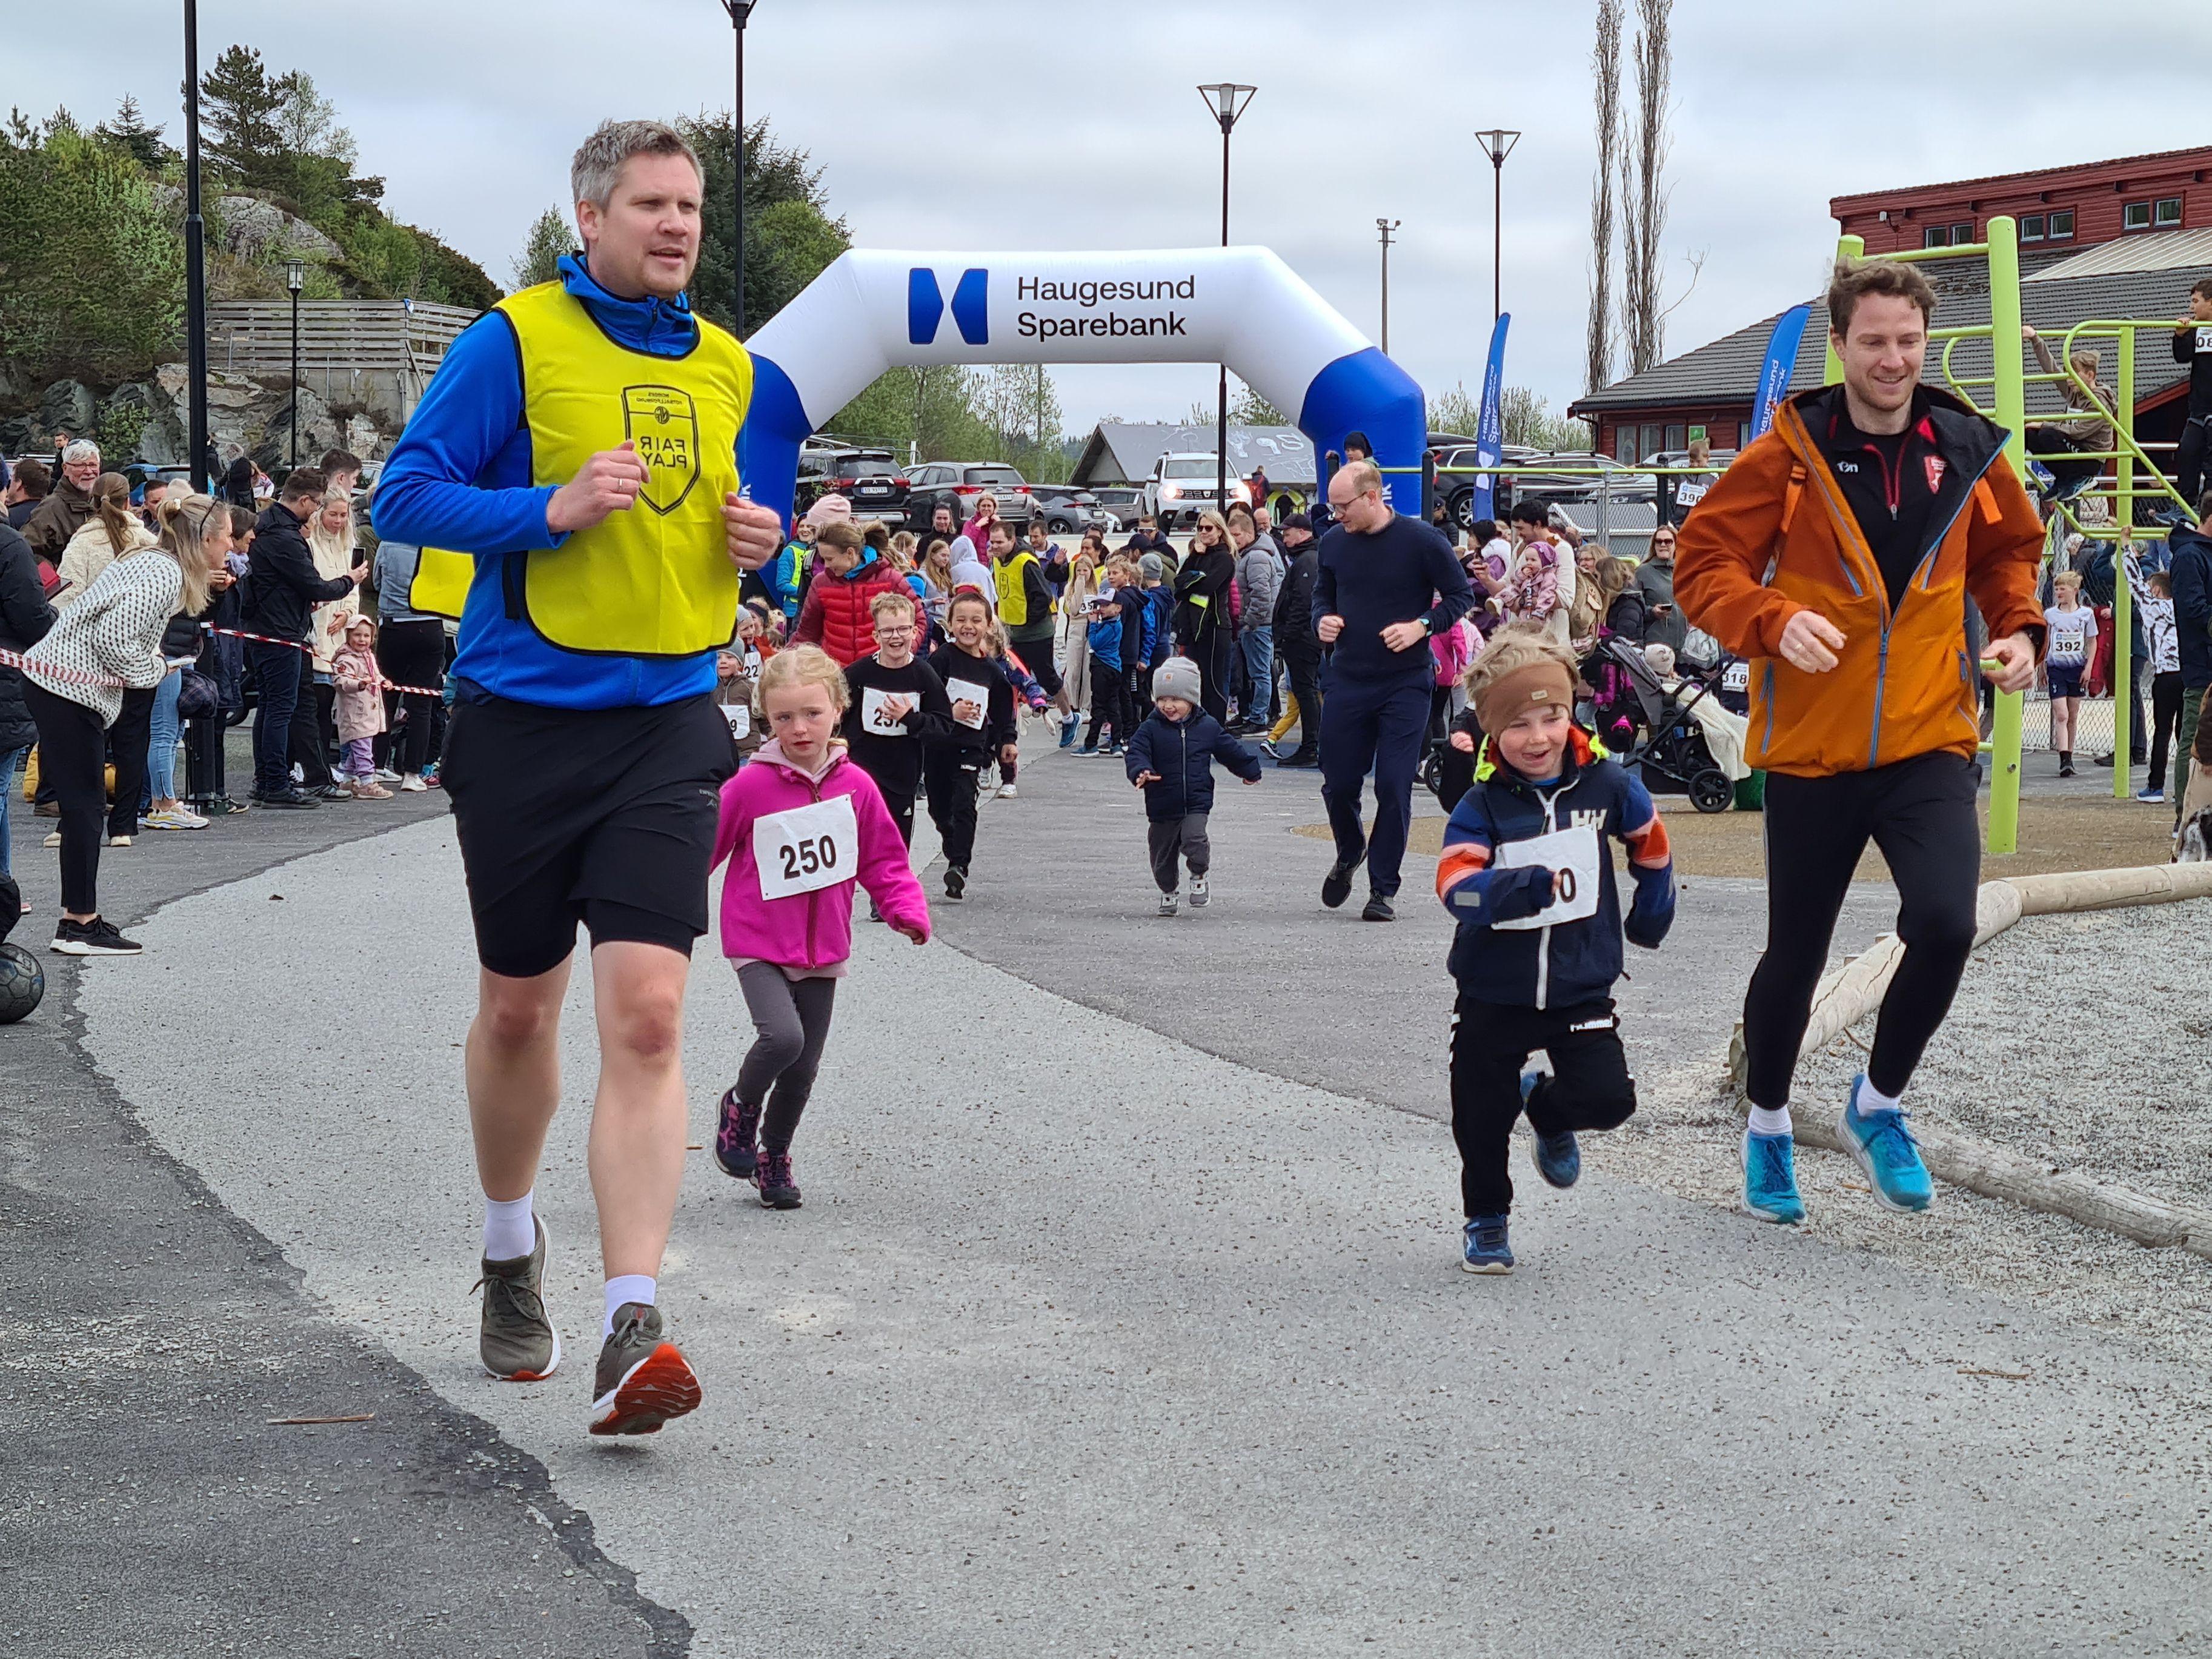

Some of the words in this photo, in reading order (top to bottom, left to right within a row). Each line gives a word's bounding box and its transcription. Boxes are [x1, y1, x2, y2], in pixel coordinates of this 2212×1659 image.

[1018, 274, 1195, 307] Haugesund
[1018, 311, 1187, 342] Sparebank
[2055, 641, 2081, 652] 392
[1722, 673, 1747, 684] 318
[779, 835, 837, 880] 250
